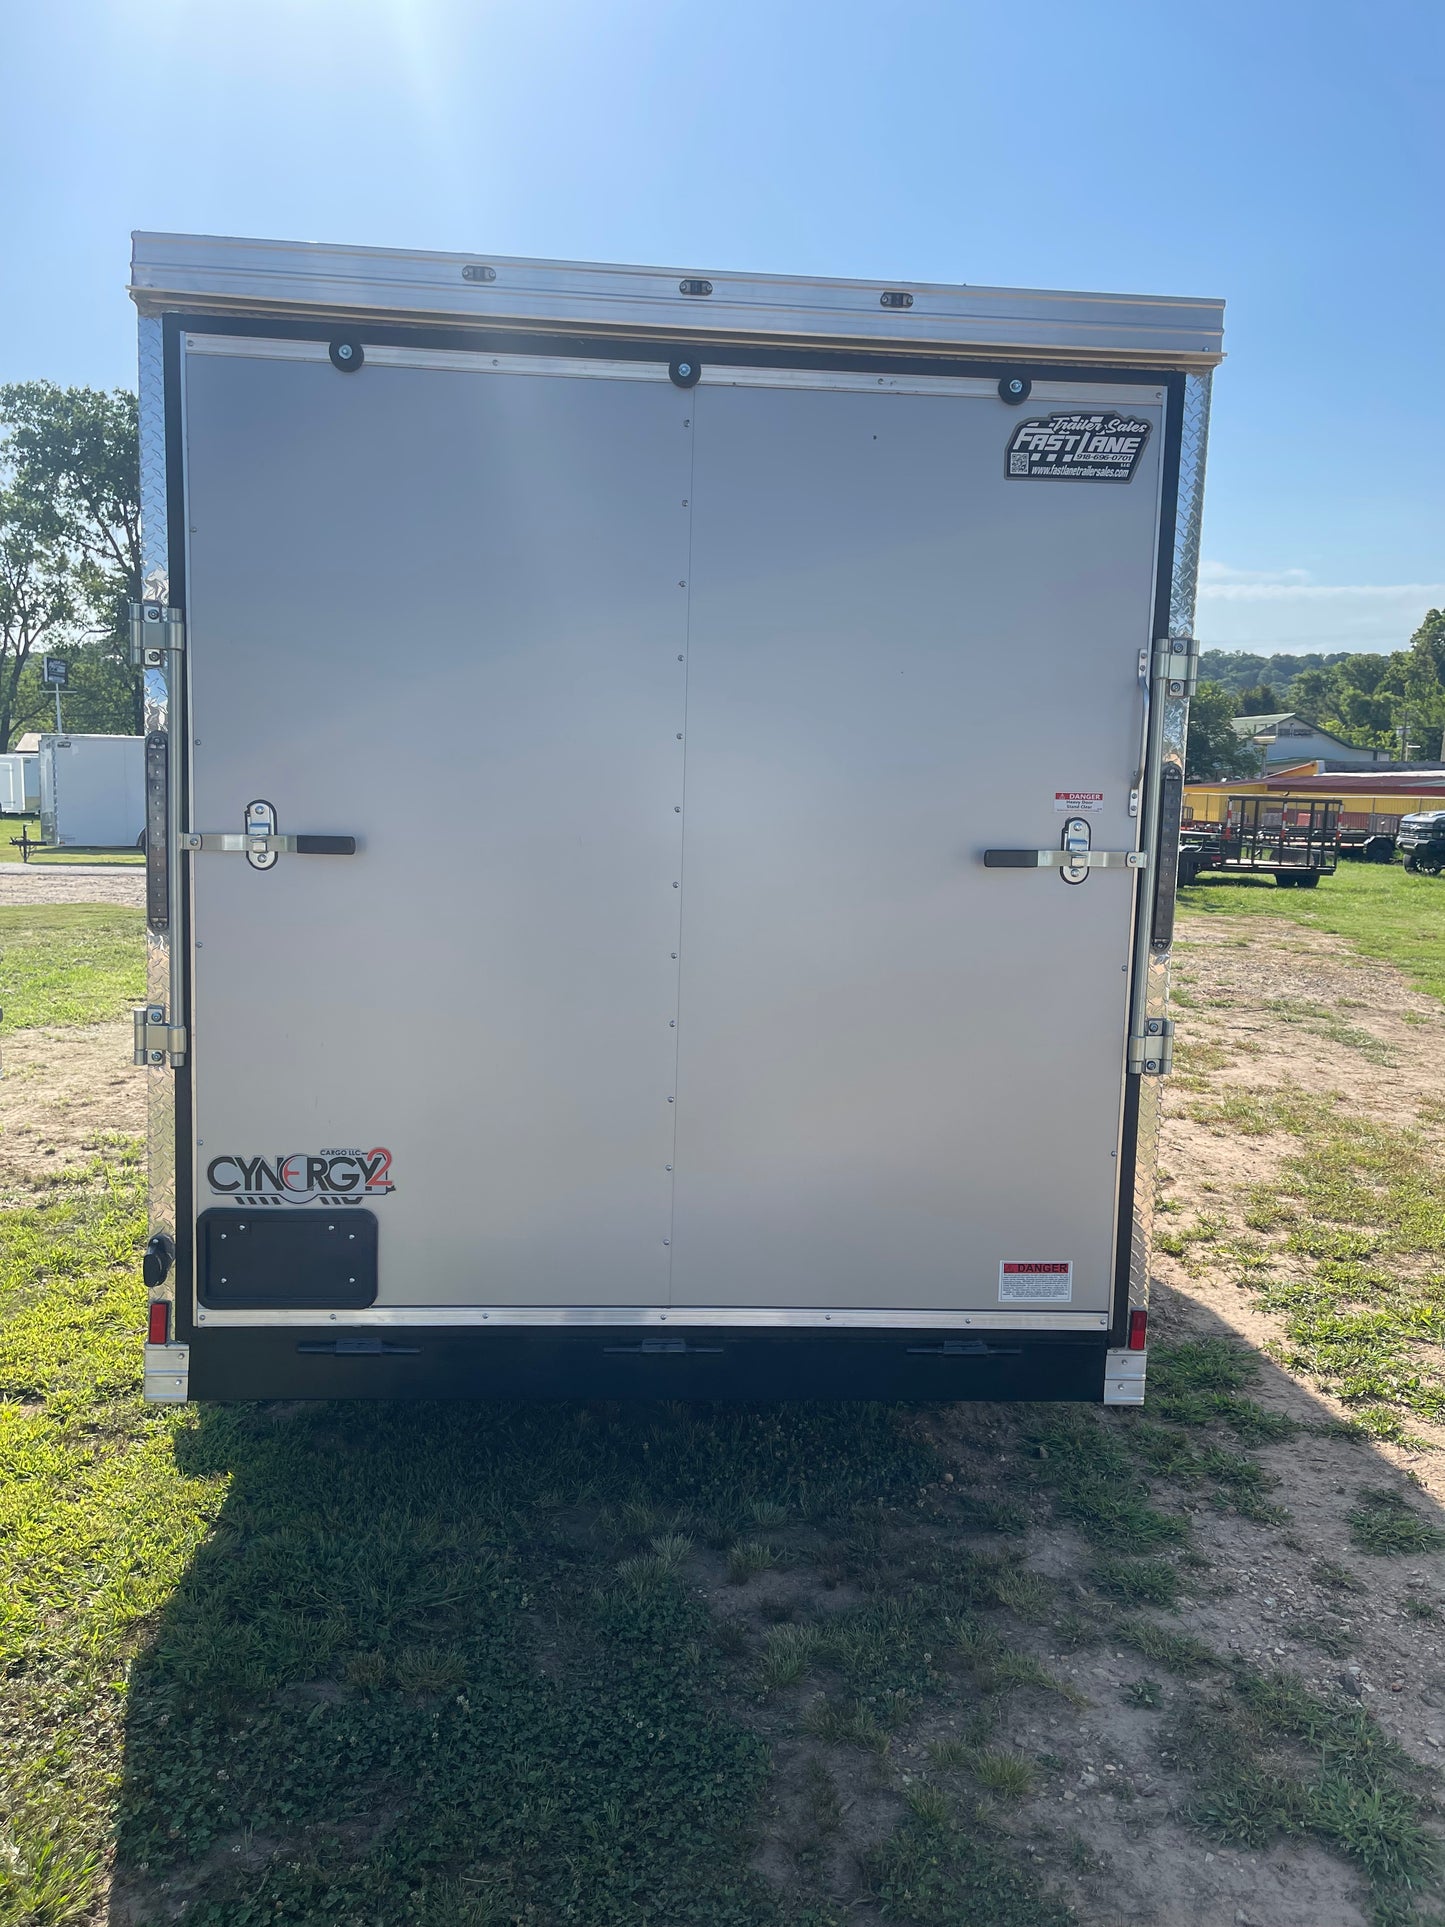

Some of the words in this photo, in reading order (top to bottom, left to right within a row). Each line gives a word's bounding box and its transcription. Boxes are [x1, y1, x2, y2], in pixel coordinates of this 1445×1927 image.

[1052, 415, 1102, 432] Trailer
[1105, 418, 1148, 433] Sales
[1031, 464, 1130, 478] www.fastlanetrailersales.com
[1017, 1263, 1067, 1273] DANGER
